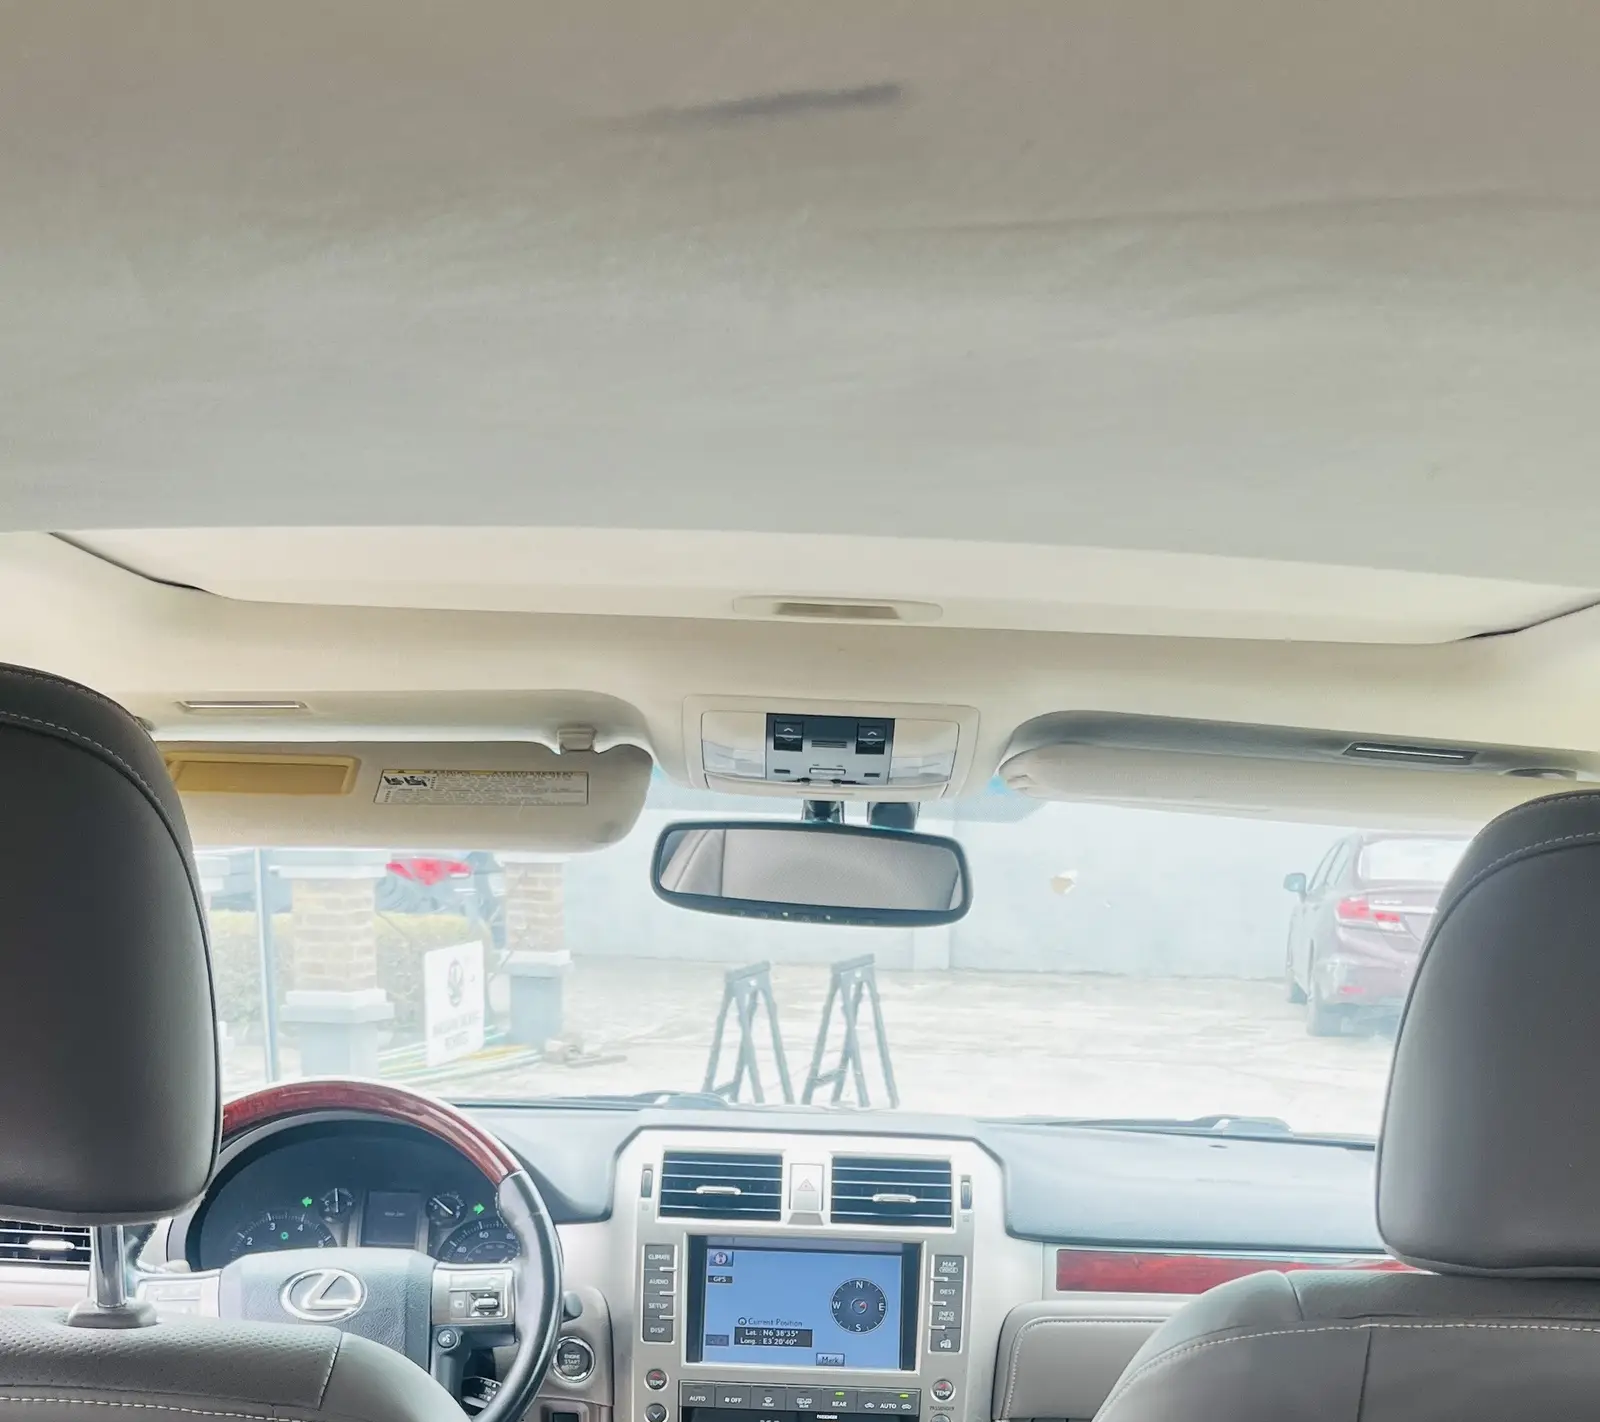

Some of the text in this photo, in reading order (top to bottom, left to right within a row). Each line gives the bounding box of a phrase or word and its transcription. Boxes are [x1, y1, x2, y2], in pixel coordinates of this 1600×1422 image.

[269, 1222, 276, 1231] 3
[297, 1224, 304, 1232] 4
[479, 1231, 489, 1239] 60
[246, 1237, 253, 1245] 2
[855, 1280, 864, 1289] N
[832, 1301, 841, 1310] W
[878, 1302, 885, 1312] E
[748, 1317, 803, 1327] Current Position
[856, 1323, 862, 1332] S
